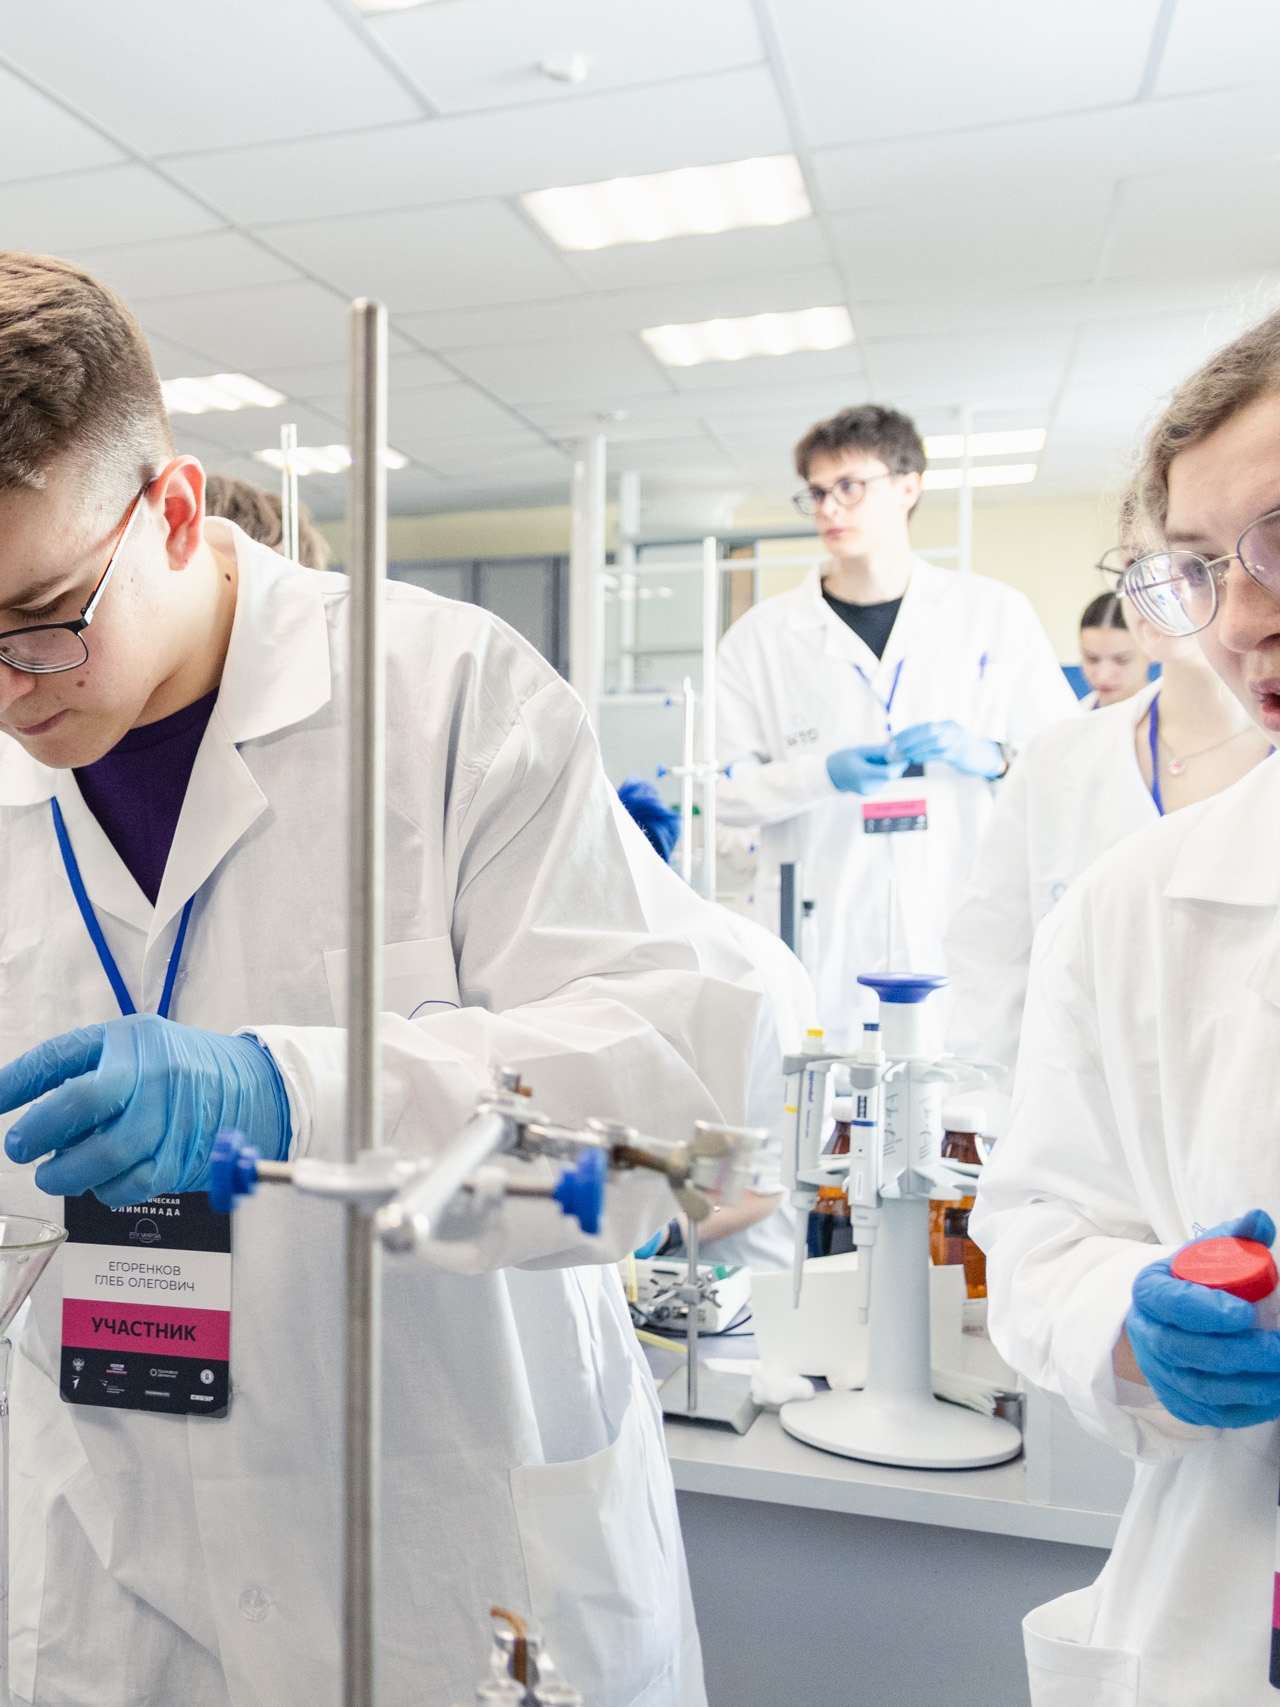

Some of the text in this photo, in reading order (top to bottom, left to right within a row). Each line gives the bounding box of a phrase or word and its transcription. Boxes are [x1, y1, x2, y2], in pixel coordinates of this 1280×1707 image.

[109, 1261, 181, 1276] ЕГОРЕНКОВ
[94, 1274, 195, 1292] ГЛЕБ ОЛЕГОВИЧ
[91, 1316, 197, 1341] УЧАСТНИК
